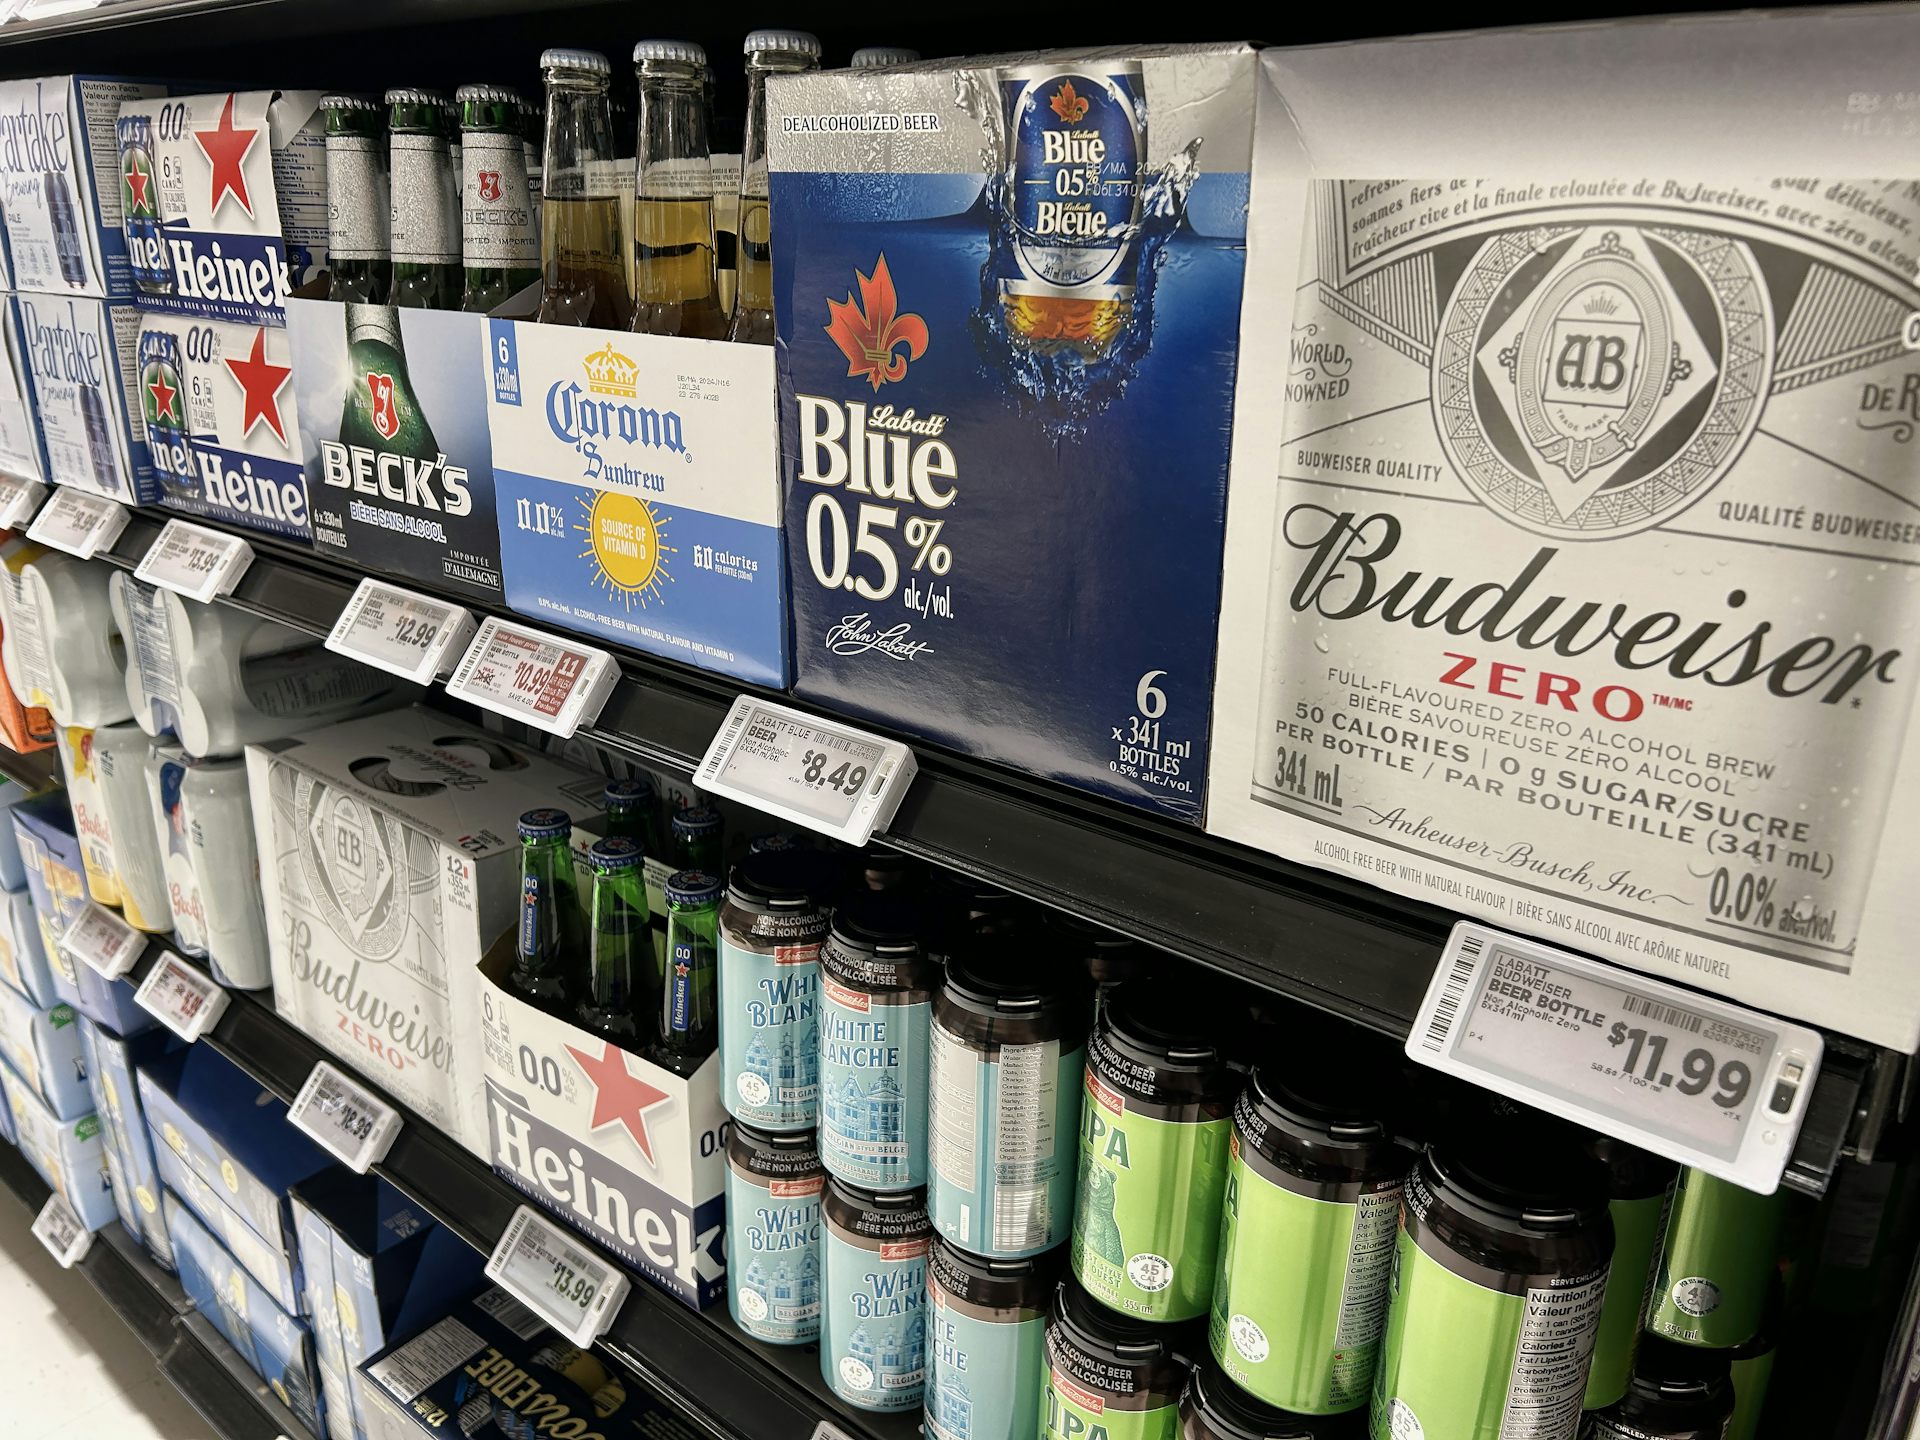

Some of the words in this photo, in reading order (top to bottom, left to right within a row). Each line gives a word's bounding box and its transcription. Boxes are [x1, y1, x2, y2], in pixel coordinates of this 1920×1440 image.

[82, 82, 118, 92] Nutrition
[83, 92, 111, 100] Valeur
[783, 114, 900, 132] DEALCOHOLIZED
[903, 114, 940, 131] BEER
[1042, 130, 1106, 164] Blue
[162, 156, 171, 178] 6
[1055, 168, 1100, 197] 0.5%
[463, 208, 529, 226] BECK'S
[1035, 202, 1108, 236] Bleue
[1351, 219, 1416, 259] fraîcheur
[1453, 198, 1469, 216] et
[1473, 192, 1489, 211] la
[1494, 184, 1543, 207] finale
[1550, 179, 1628, 200] veloutée
[1632, 179, 1655, 198] de
[1661, 180, 1771, 218] Budweiser,
[1774, 205, 1823, 229] avec
[1824, 217, 1867, 247] zéro
[21, 301, 102, 388] Partake
[498, 336, 510, 364] 6
[1290, 338, 1348, 369] WORLD
[1556, 333, 1627, 392] AB
[192, 376, 201, 396] 6
[545, 379, 688, 455] Corona
[868, 404, 948, 436] Labatt
[1556, 409, 1580, 432] TRADE
[1583, 412, 1611, 432] MARK
[582, 441, 666, 493] Sunbrew
[796, 394, 959, 510] Blue
[1297, 450, 1371, 475] BUDWEISER
[1376, 459, 1443, 483] QUALITY
[320, 439, 472, 517] BECK'S
[350, 499, 378, 527] BIÈRE
[377, 508, 405, 533] SANS
[404, 514, 448, 544] ALCOOL
[600, 517, 634, 539] SOURCE
[635, 526, 647, 542] OF
[1719, 501, 1805, 530] QUALITÉ
[316, 527, 348, 548] BOUTEILLES
[602, 535, 638, 558] VITAMIN
[639, 544, 647, 560] D
[805, 492, 954, 602] 0.5%
[444, 562, 500, 588] D'ALLEMAGNE
[450, 550, 490, 568] IMPORTÉE
[693, 544, 713, 571] 60
[714, 551, 758, 572] calories
[903, 577, 954, 620] alc./vol.
[1282, 503, 1902, 705] Budweiser
[395, 615, 438, 649] $12.99
[574, 607, 612, 626] ALCOHOL-FREE
[611, 616, 626, 631] BEER
[625, 621, 640, 635] WITH
[640, 624, 666, 642] NATURAL
[665, 631, 692, 649] FLAVOUR
[691, 639, 704, 653] AND
[704, 642, 726, 660] VITAMIN
[725, 649, 735, 663] D
[514, 660, 552, 696] $10.99
[558, 655, 581, 679] 11
[1136, 670, 1168, 719] 6
[1438, 651, 1645, 723] ZERO
[1652, 693, 1694, 712] TM/MC
[748, 726, 778, 743] BEER
[753, 715, 788, 732] LABATT
[788, 725, 811, 740] BLUE
[1111, 727, 1123, 741] x
[1127, 716, 1161, 751] 341
[1165, 740, 1191, 759] ml
[1328, 667, 1504, 721] FULL-FLAVOURED
[1510, 710, 1572, 737] ZERO
[1579, 728, 1698, 765] ALCOHOL
[1705, 753, 1776, 781] BREW
[1119, 744, 1181, 776] BOTTLES
[1348, 693, 1404, 720] BIÈRE
[1408, 708, 1560, 758] SAVOUREUSE
[1565, 744, 1629, 773] ZÉRO
[1636, 761, 1735, 797] ALCOOL
[802, 749, 868, 796] $8.49
[1109, 760, 1139, 778] 0.5%
[1141, 772, 1193, 793] alc./vol.
[1274, 746, 1308, 796] 341
[1313, 764, 1343, 808] mL
[1295, 702, 1325, 725] 50
[1331, 711, 1470, 763] CALORIES
[1530, 767, 1546, 787] g
[1556, 770, 1812, 843] SUGAR/SUCRE
[1275, 719, 1315, 744] PER
[1322, 733, 1415, 773] BOTTLE
[1445, 767, 1505, 798] PAR
[1517, 786, 1697, 844] BOUTEILLE
[1707, 829, 1777, 863] (341
[1786, 851, 1835, 880] mL)
[337, 825, 363, 869] AB
[1366, 806, 1594, 892] Anheuser-Busch,
[1597, 871, 1657, 905] Inc.
[447, 855, 464, 877] 12
[1314, 839, 1351, 864] ALCOHOL
[1353, 850, 1374, 871] FREE
[1375, 857, 1397, 878] BEER
[1399, 865, 1422, 885] WITH
[1424, 872, 1463, 898] NATURAL
[1465, 885, 1506, 910] FLAVOUR
[1516, 898, 1543, 922] BIÈRE
[1545, 909, 1572, 930] SANS
[1574, 920, 1612, 943] ALCOOL
[1614, 930, 1641, 951] AVEC
[1642, 939, 1681, 965] ARÔME
[1684, 952, 1731, 980] NATUREL
[525, 907, 534, 950] Heineken
[842, 965, 898, 986] ALCOOLISÉE
[873, 962, 896, 974] BEER
[1493, 966, 1573, 1001] BUDWEISER
[1497, 955, 1551, 980] LABATT
[675, 980, 686, 1026] Heineken
[759, 972, 817, 1006] WHI
[1488, 977, 1533, 1004] BEER
[1536, 993, 1606, 1029] BOTTLE
[483, 991, 494, 1022] 6
[1484, 992, 1504, 1007] Non
[1507, 1000, 1555, 1024] Alcoholic
[1556, 1016, 1581, 1032] Zero
[335, 1009, 406, 1072] ZERO
[819, 1008, 887, 1043] WHITE
[519, 1043, 562, 1097] 0.0
[1098, 1060, 1156, 1096] ALCOOLISÉE
[1130, 1064, 1156, 1082] BEER
[1607, 1020, 1753, 1110] $11.99
[1360, 1204, 1394, 1219] Valeur
[1354, 1239, 1389, 1251] Calories
[553, 1261, 596, 1308] $13.99
[863, 1267, 922, 1299] WHI
[950, 1264, 970, 1284] BEER
[1140, 1262, 1160, 1276] 45
[1529, 1305, 1572, 1317] Valeur
[1531, 1289, 1587, 1304] Nutrition
[1050, 1322, 1107, 1375] NON-ALCOHOLIC
[1107, 1365, 1133, 1380] BEER
[1522, 1340, 1565, 1351] Calories
[1566, 1337, 1577, 1347] 45
[463, 1347, 543, 1410] EDGE
[848, 1365, 863, 1377] 45
[1055, 1349, 1073, 1371] NON
[1072, 1365, 1135, 1393] ALCOOLISÉE
[1614, 1422, 1645, 1440] CHILLED
